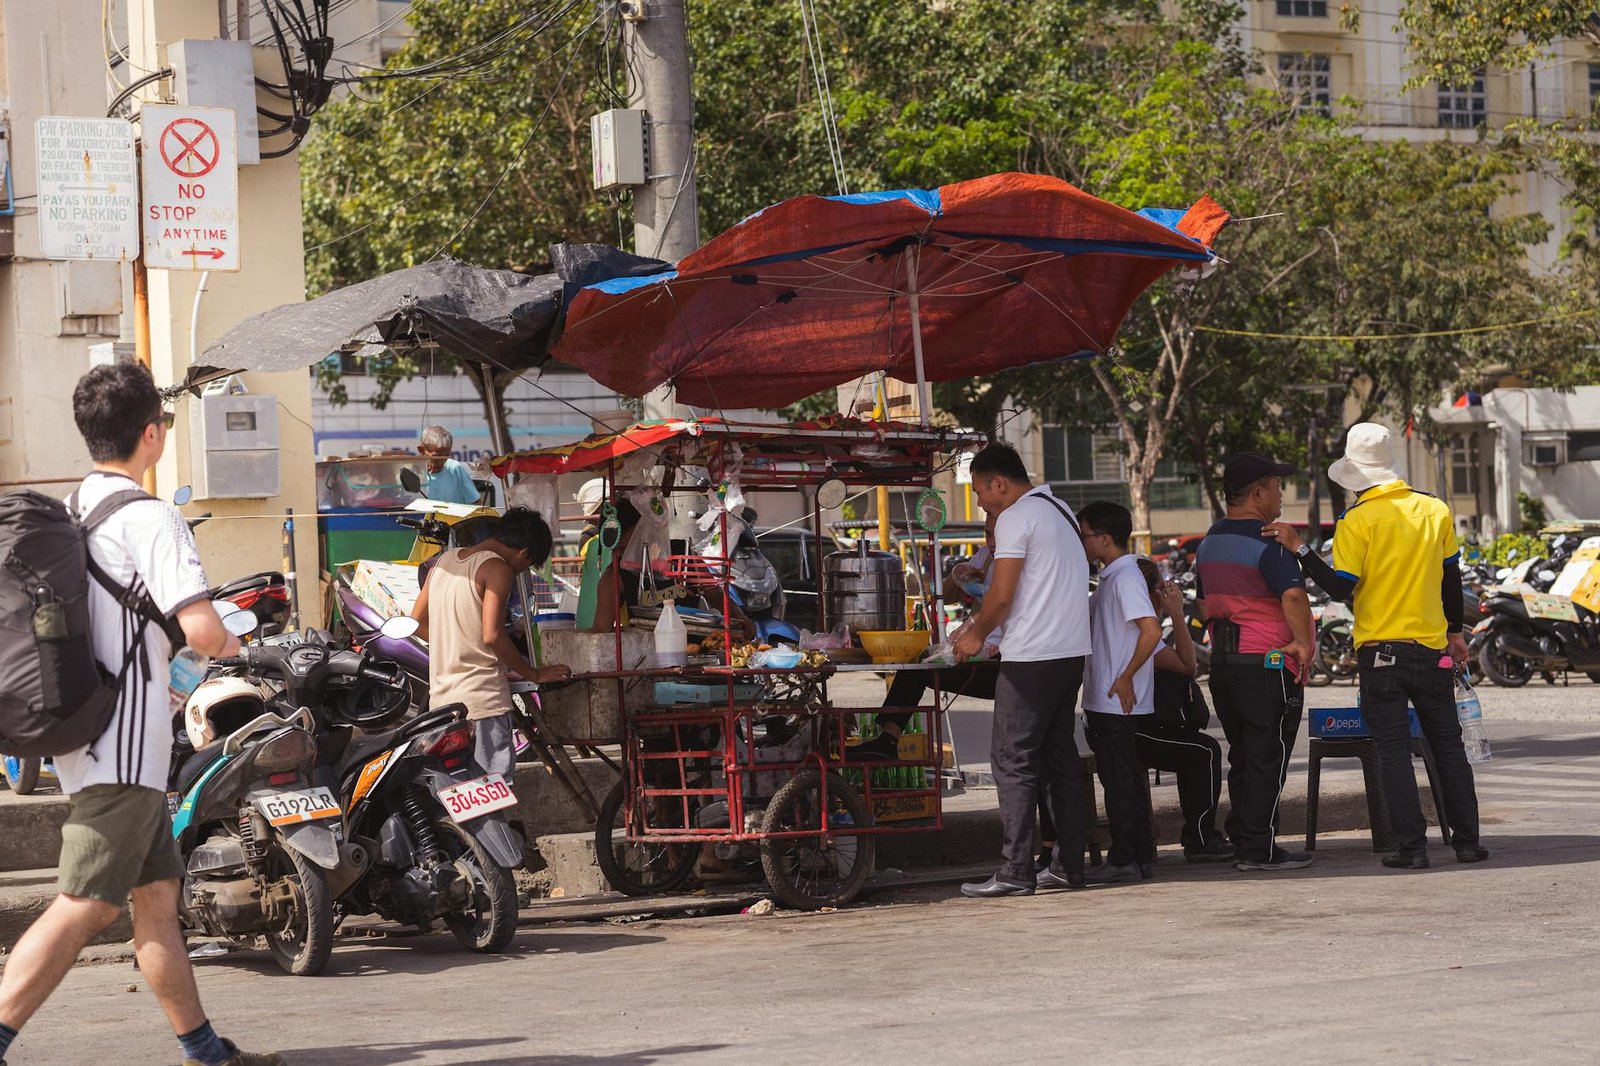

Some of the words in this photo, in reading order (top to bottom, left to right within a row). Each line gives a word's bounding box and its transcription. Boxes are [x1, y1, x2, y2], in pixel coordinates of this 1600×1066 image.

[40, 121, 57, 137] PAY
[60, 121, 102, 137] PARKING
[105, 122, 129, 138] ZONE
[41, 138, 60, 148] FOR
[67, 139, 130, 149] MOTORCYCLE
[70, 150, 82, 160] FOR
[110, 152, 129, 161] HOUR
[41, 161, 52, 170] OR
[97, 162, 130, 172] THEREOF
[178, 183, 205, 199] NO
[82, 195, 103, 206] YOU
[105, 196, 131, 207] PARK
[49, 207, 67, 220] NO
[72, 207, 128, 221] PARKING
[75, 233, 103, 243] DAILY
[163, 228, 227, 240] ANYTIME
[1336, 717, 1361, 730] pepsi
[446, 781, 509, 813] 304SGD
[266, 793, 335, 818] G192LR
